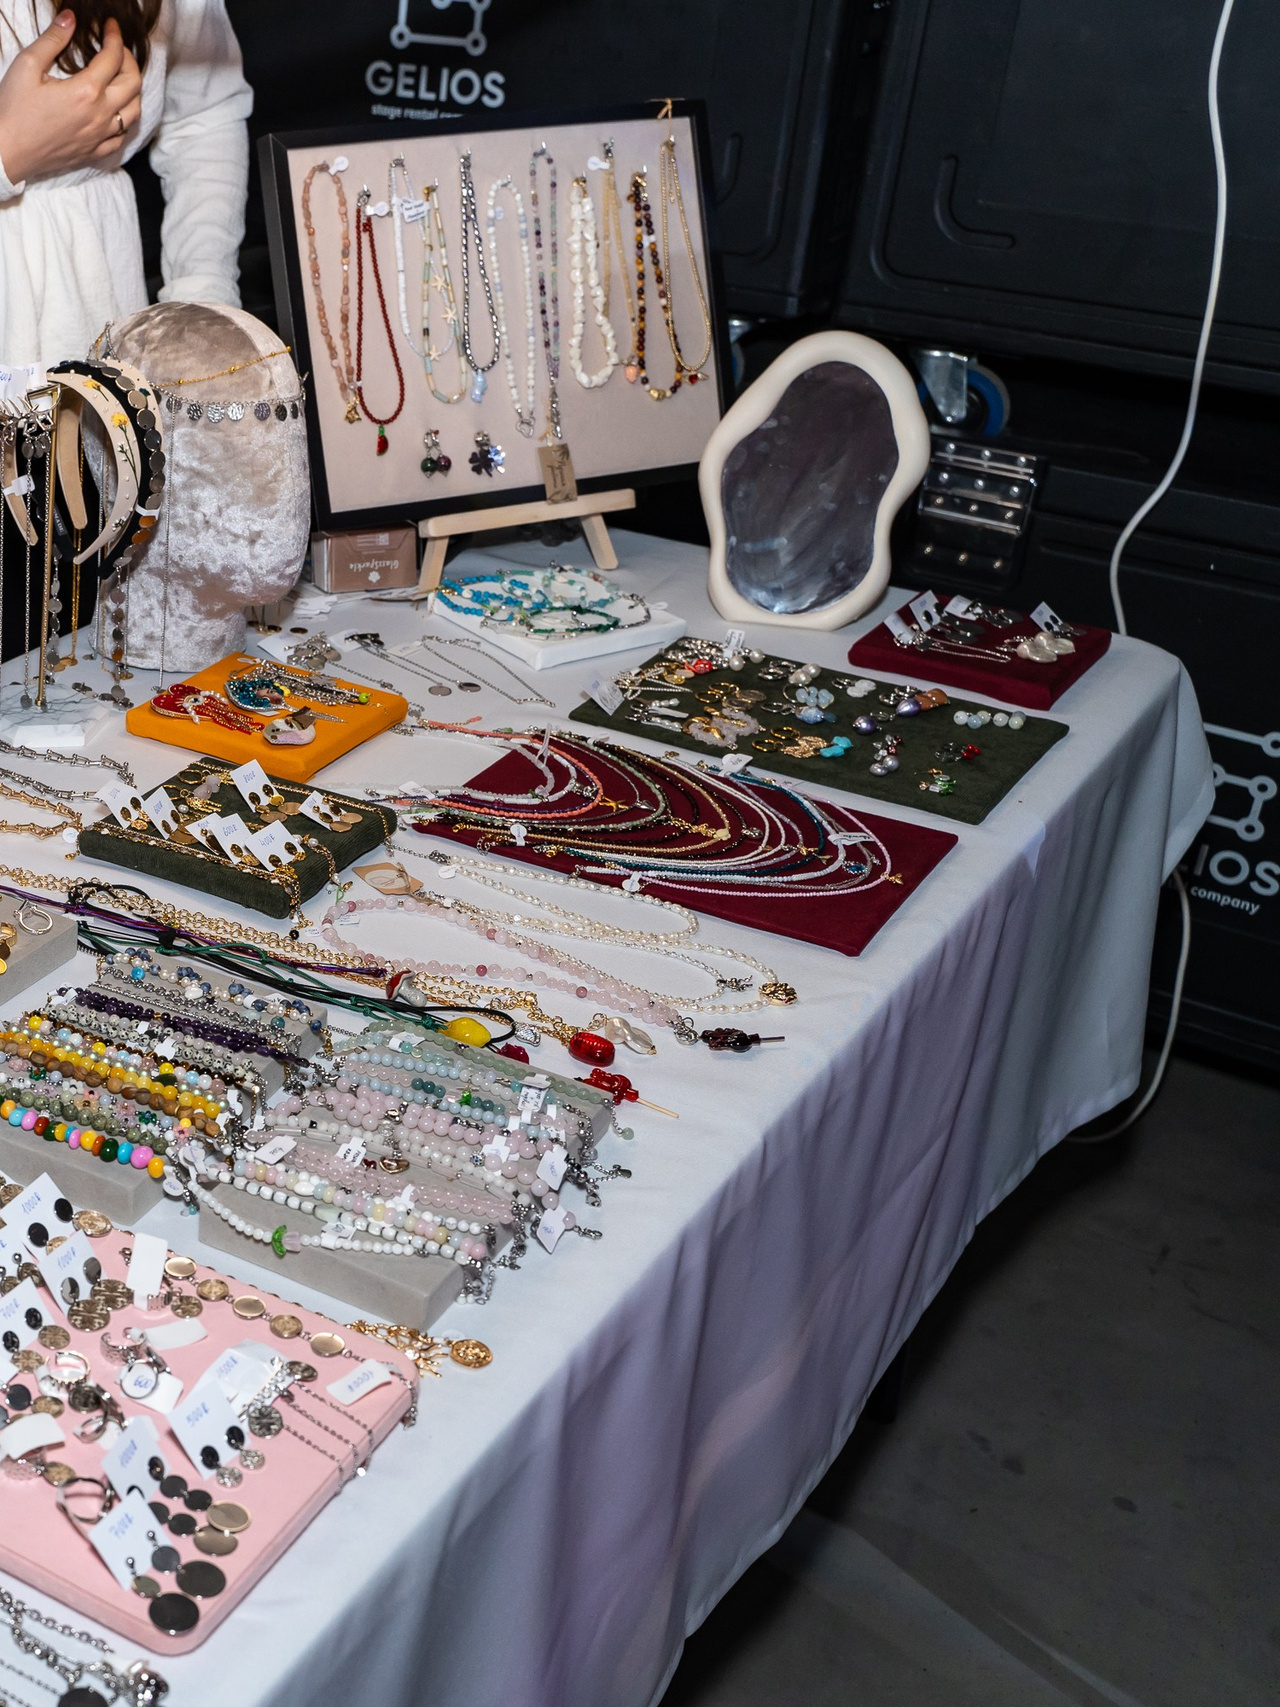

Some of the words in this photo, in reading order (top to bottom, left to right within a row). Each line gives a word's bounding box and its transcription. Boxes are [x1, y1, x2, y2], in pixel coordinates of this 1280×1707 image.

[365, 60, 506, 108] GELIOS
[371, 104, 402, 120] stage
[349, 560, 400, 571] GlassSparkle
[1192, 843, 1280, 896] IOS
[1190, 886, 1260, 915] company
